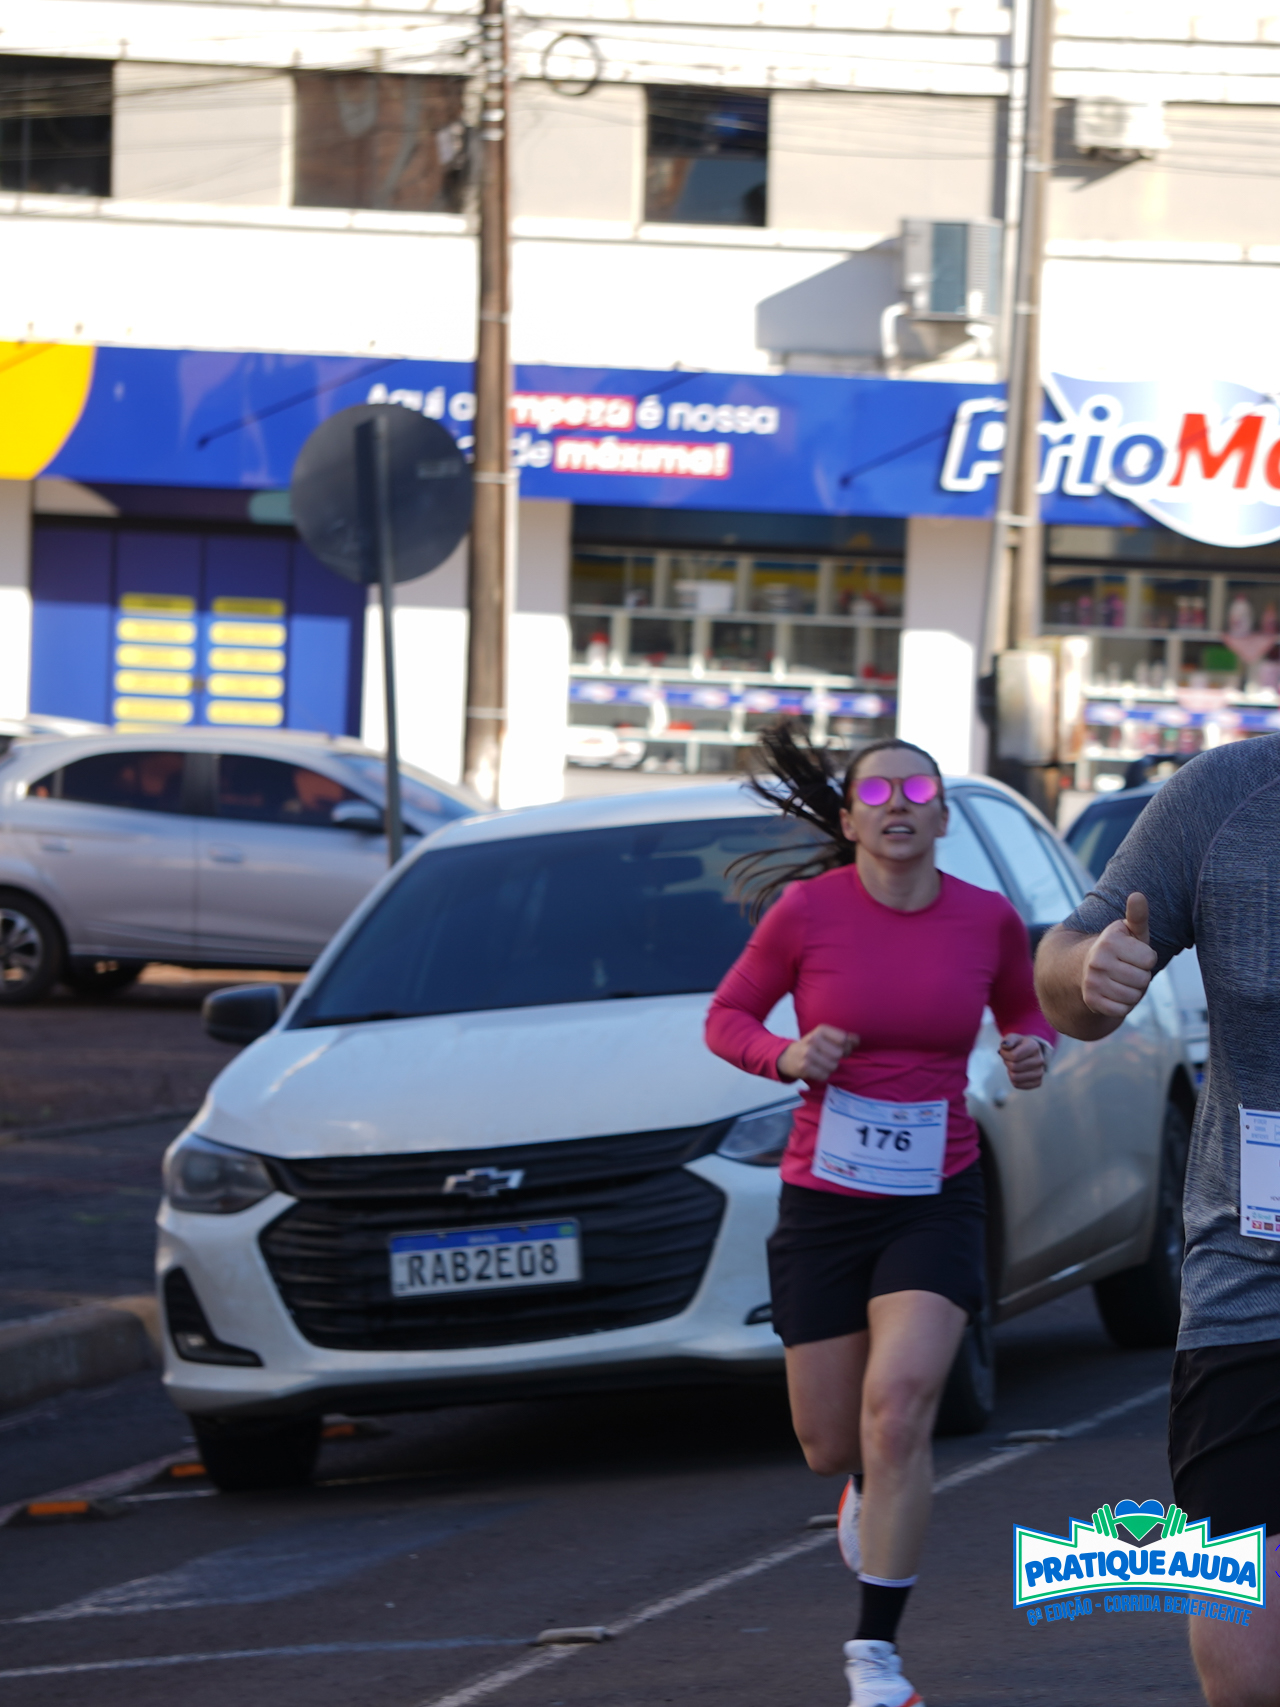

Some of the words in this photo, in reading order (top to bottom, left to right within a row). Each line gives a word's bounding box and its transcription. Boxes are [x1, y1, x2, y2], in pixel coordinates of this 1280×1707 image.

[635, 393, 664, 430] é
[667, 401, 780, 435] nossa
[556, 435, 729, 477] máxima!
[856, 1125, 912, 1151] 176
